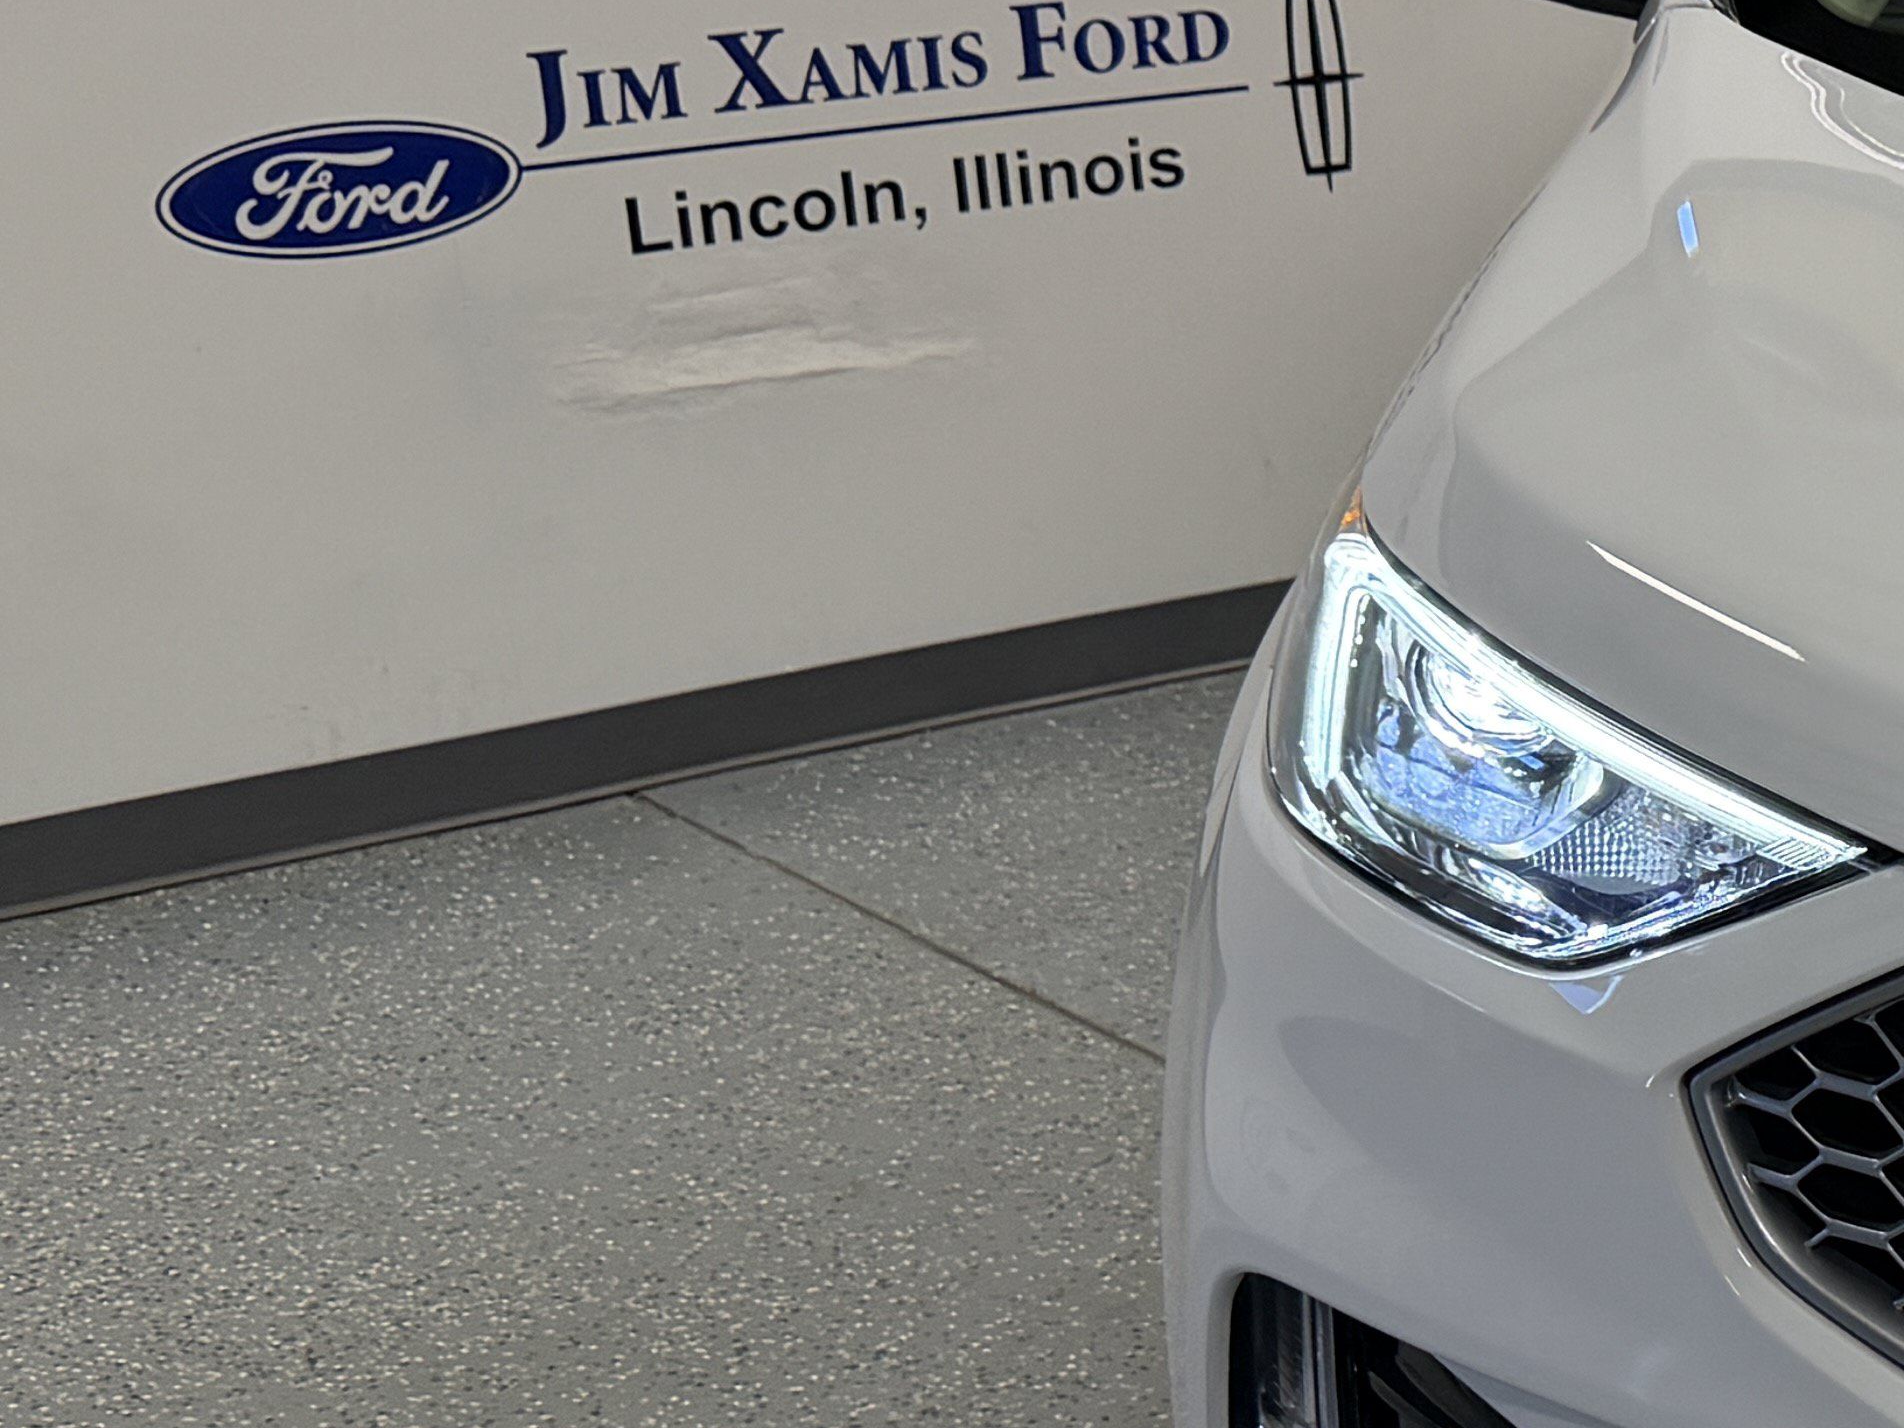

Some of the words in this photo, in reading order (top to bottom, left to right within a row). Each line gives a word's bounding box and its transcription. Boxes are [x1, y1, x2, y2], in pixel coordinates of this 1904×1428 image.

[527, 49, 688, 149] JIM
[708, 28, 988, 114] XAMIS
[1010, 1, 1229, 81] FORD
[234, 146, 451, 240] Ford
[624, 170, 927, 255] Lincoln,
[954, 138, 1185, 214] Illinois
